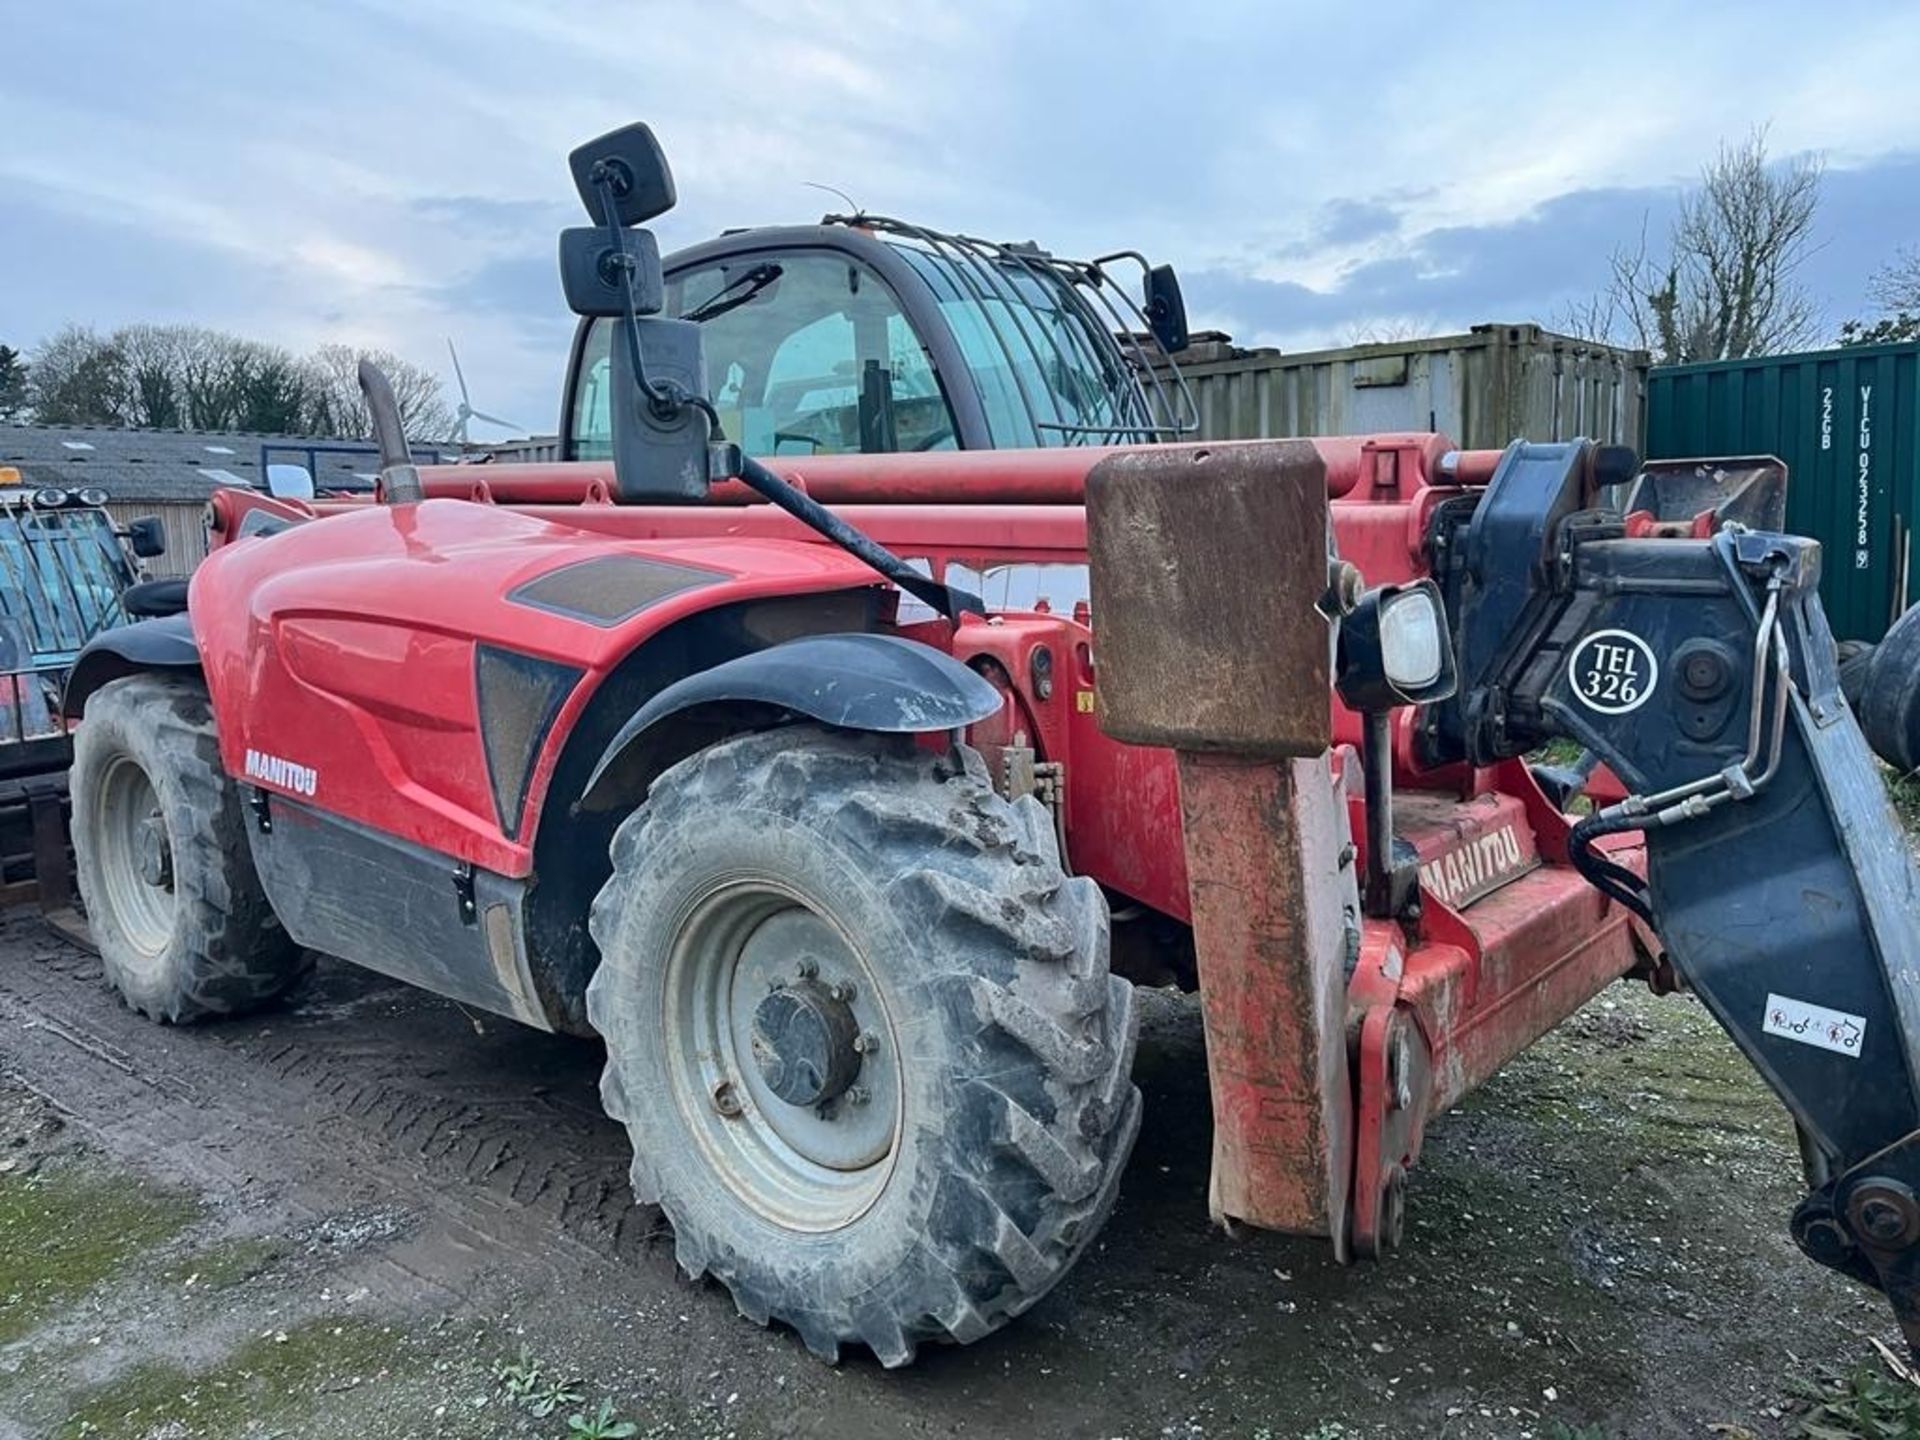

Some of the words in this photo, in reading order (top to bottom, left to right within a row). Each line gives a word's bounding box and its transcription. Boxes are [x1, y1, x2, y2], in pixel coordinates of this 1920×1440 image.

[1858, 452, 1868, 545] 023258
[1593, 643, 1638, 676] TEL
[1583, 670, 1638, 704] 326
[245, 748, 317, 796] MANITOU
[1420, 824, 1520, 901] MANITOU
